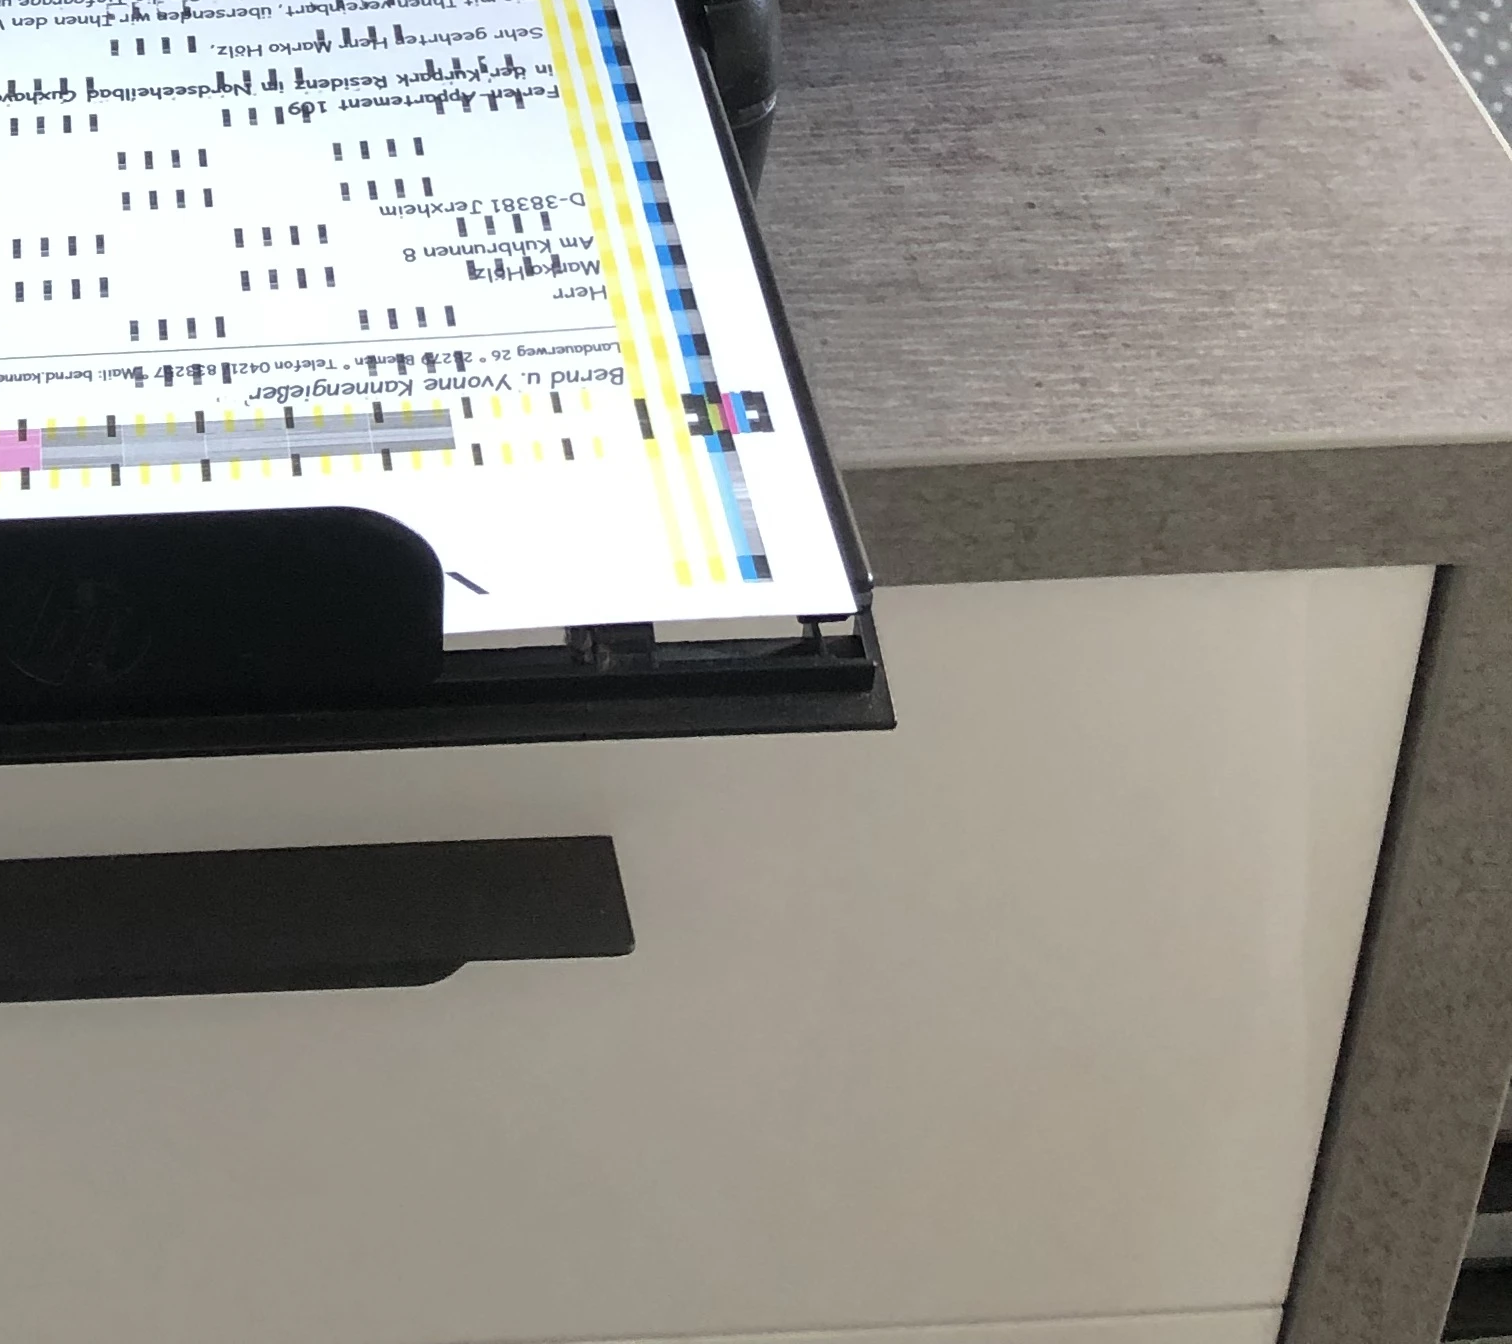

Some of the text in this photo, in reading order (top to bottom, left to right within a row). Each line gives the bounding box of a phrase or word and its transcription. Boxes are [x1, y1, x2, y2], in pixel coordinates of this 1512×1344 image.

[120, 11, 150, 25] wir
[157, 5, 272, 25] übersenden
[278, 0, 390, 18] vereinbart,
[12, 16, 48, 30] den
[55, 13, 112, 28] Ihnen
[396, 26, 487, 46] geehrter
[494, 26, 543, 41] Sehr
[268, 39, 332, 55] Marko
[338, 36, 388, 52] Herr
[396, 66, 480, 87] Kurpark
[492, 65, 526, 81] der
[87, 82, 251, 103] Nordseeheilbad
[295, 75, 387, 93] Residenz
[288, 101, 327, 116] 109
[378, 192, 585, 219] D-38381 Jerxheim
[402, 236, 594, 263] Am Kuhbrunnen 8
[474, 260, 600, 284] Marko Hölz
[553, 284, 607, 302] Herr
[97, 341, 621, 382] Landauerweg 26 Telefon Mail:
[249, 367, 624, 404] Bernd u. Yvonne Kannengießer
